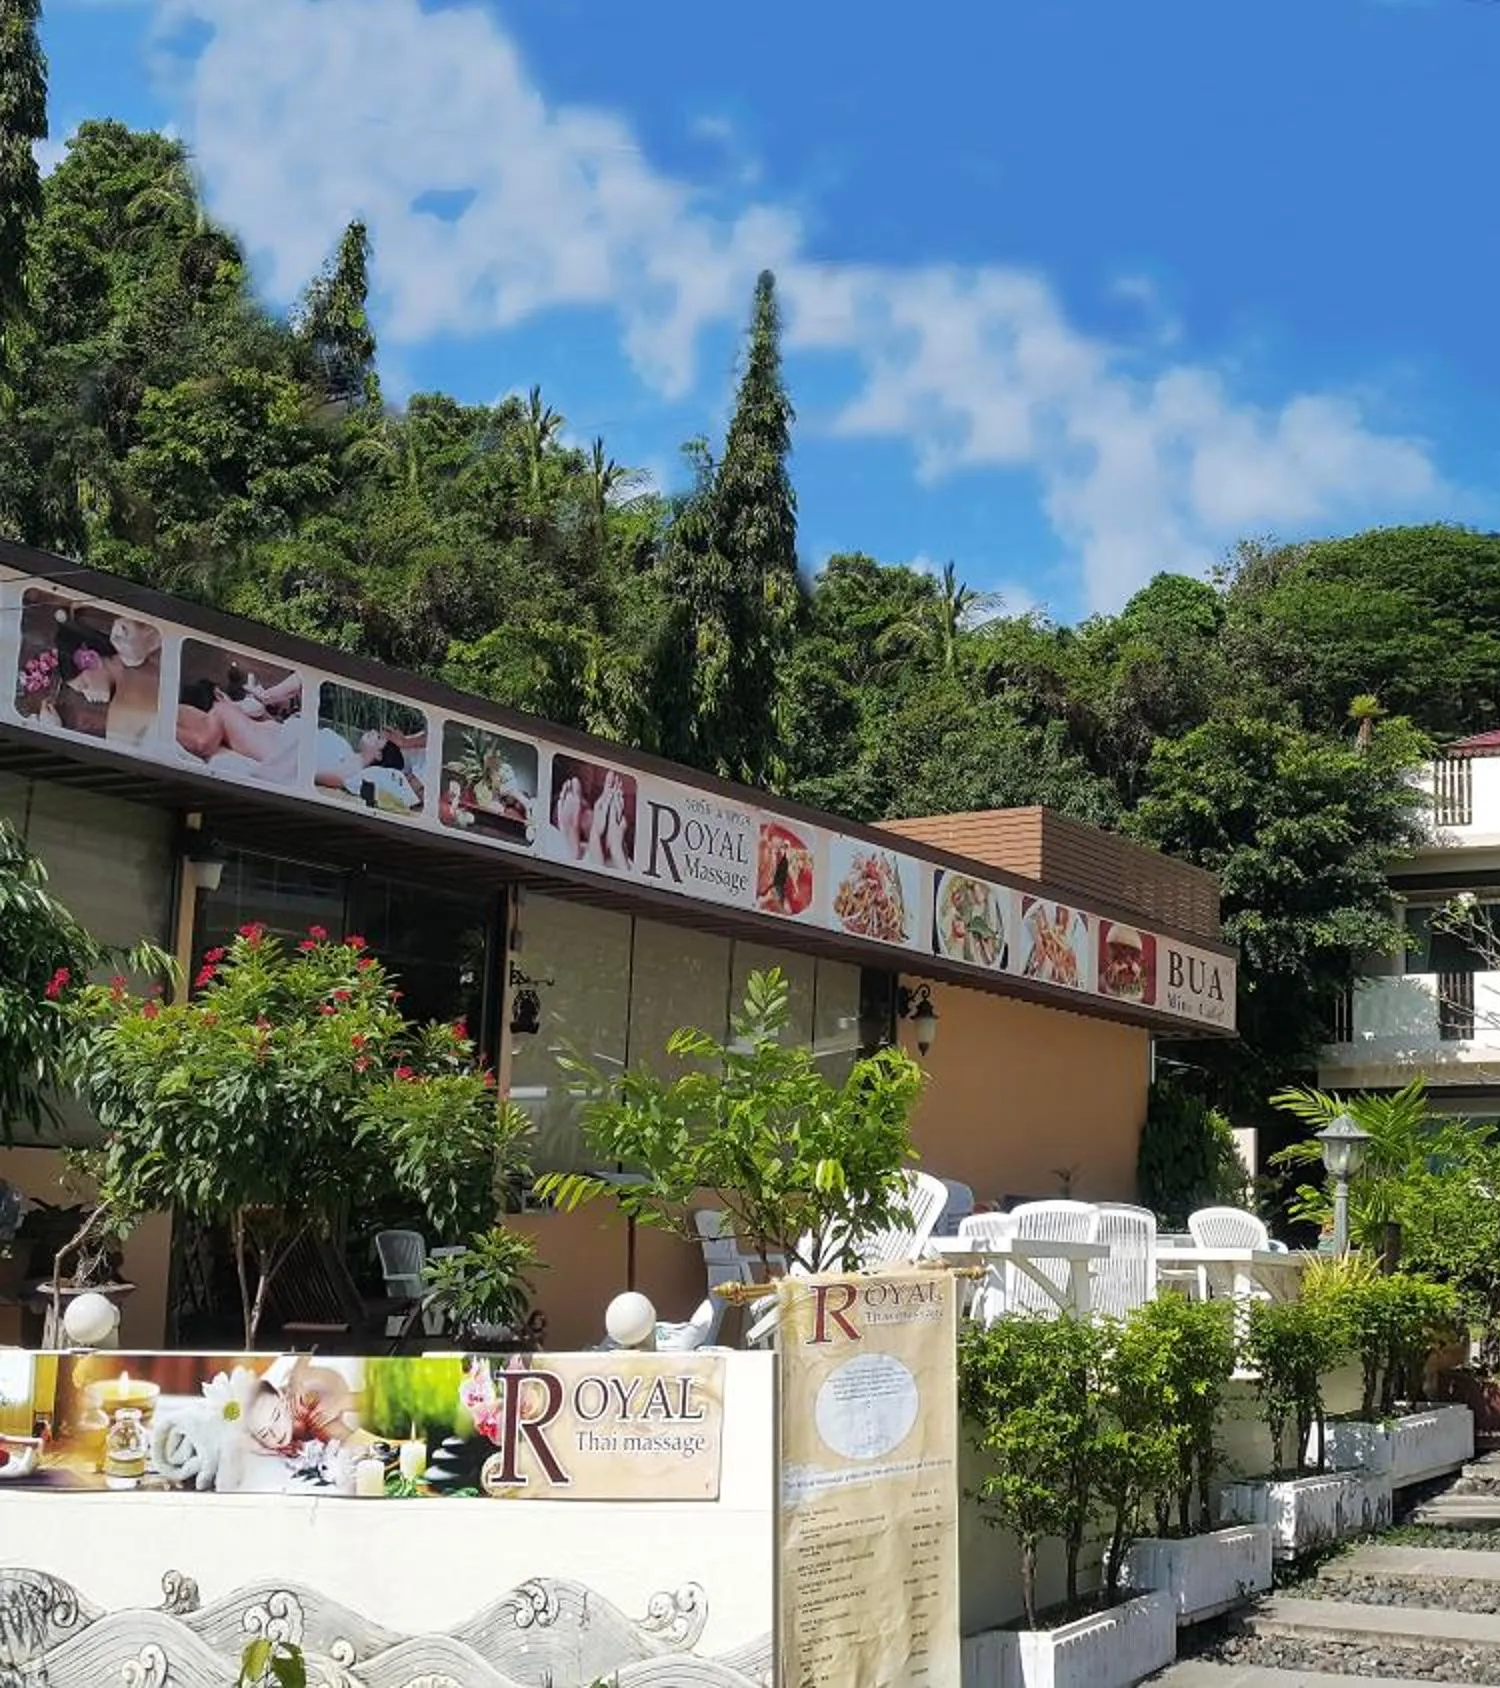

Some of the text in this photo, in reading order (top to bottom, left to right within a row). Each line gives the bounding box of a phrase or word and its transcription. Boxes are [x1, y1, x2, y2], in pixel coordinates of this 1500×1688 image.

[642, 800, 749, 884] ROYAL
[683, 853, 749, 897] Massage
[1167, 949, 1225, 1002] BUA
[806, 1282, 943, 1344] ROYAL
[490, 1370, 705, 1484] ROYAL
[575, 1430, 706, 1458] Thai massage
